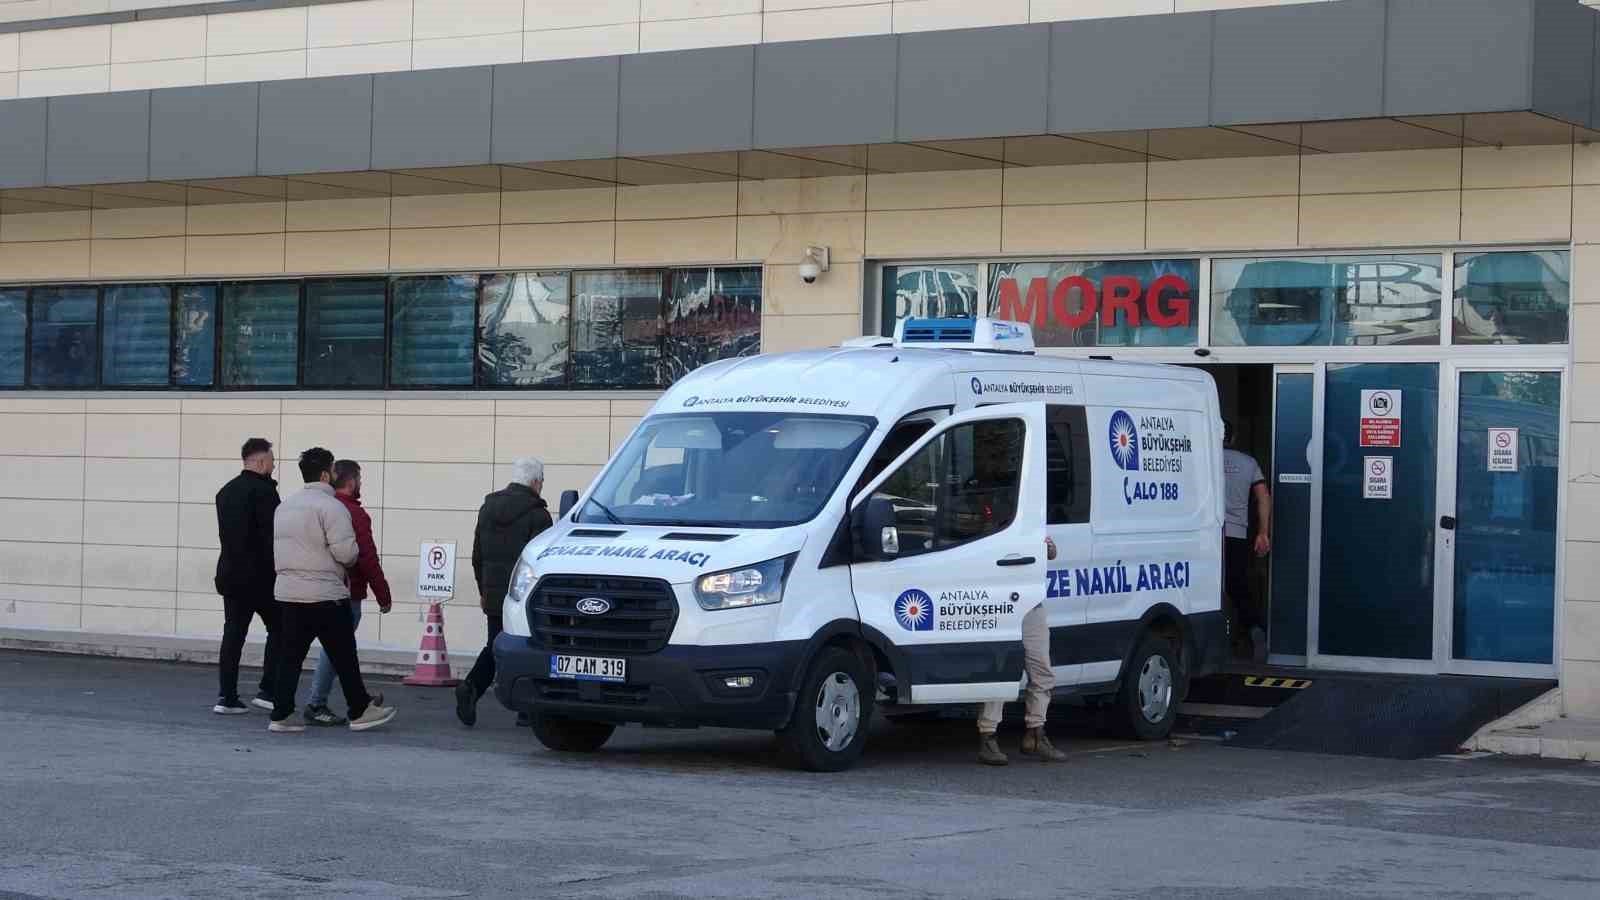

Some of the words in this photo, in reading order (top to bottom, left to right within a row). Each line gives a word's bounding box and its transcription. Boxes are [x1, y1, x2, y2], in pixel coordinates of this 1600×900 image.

[999, 275, 1192, 329] MORG
[983, 383, 1008, 393] ANTALYA
[697, 398, 734, 407] ANTALYA
[1140, 416, 1175, 431] ANTALYA
[1141, 434, 1192, 455] BÜYÜKŞEHİR
[1143, 456, 1183, 472] BELEDİYESİ
[1133, 482, 1158, 500] ALO
[1160, 482, 1179, 501] 188
[649, 549, 711, 568] ARACI
[1136, 561, 1190, 592] ARACI
[420, 584, 452, 593] YAPILMAZ
[940, 590, 989, 601] ANTALYA
[582, 600, 604, 612] Ford
[940, 602, 1015, 617] BÜYÜKŞEHİR
[939, 617, 997, 631] BELEDİYESİ
[558, 656, 571, 673] 07
[575, 657, 597, 674] CAM
[601, 660, 624, 676] 319
